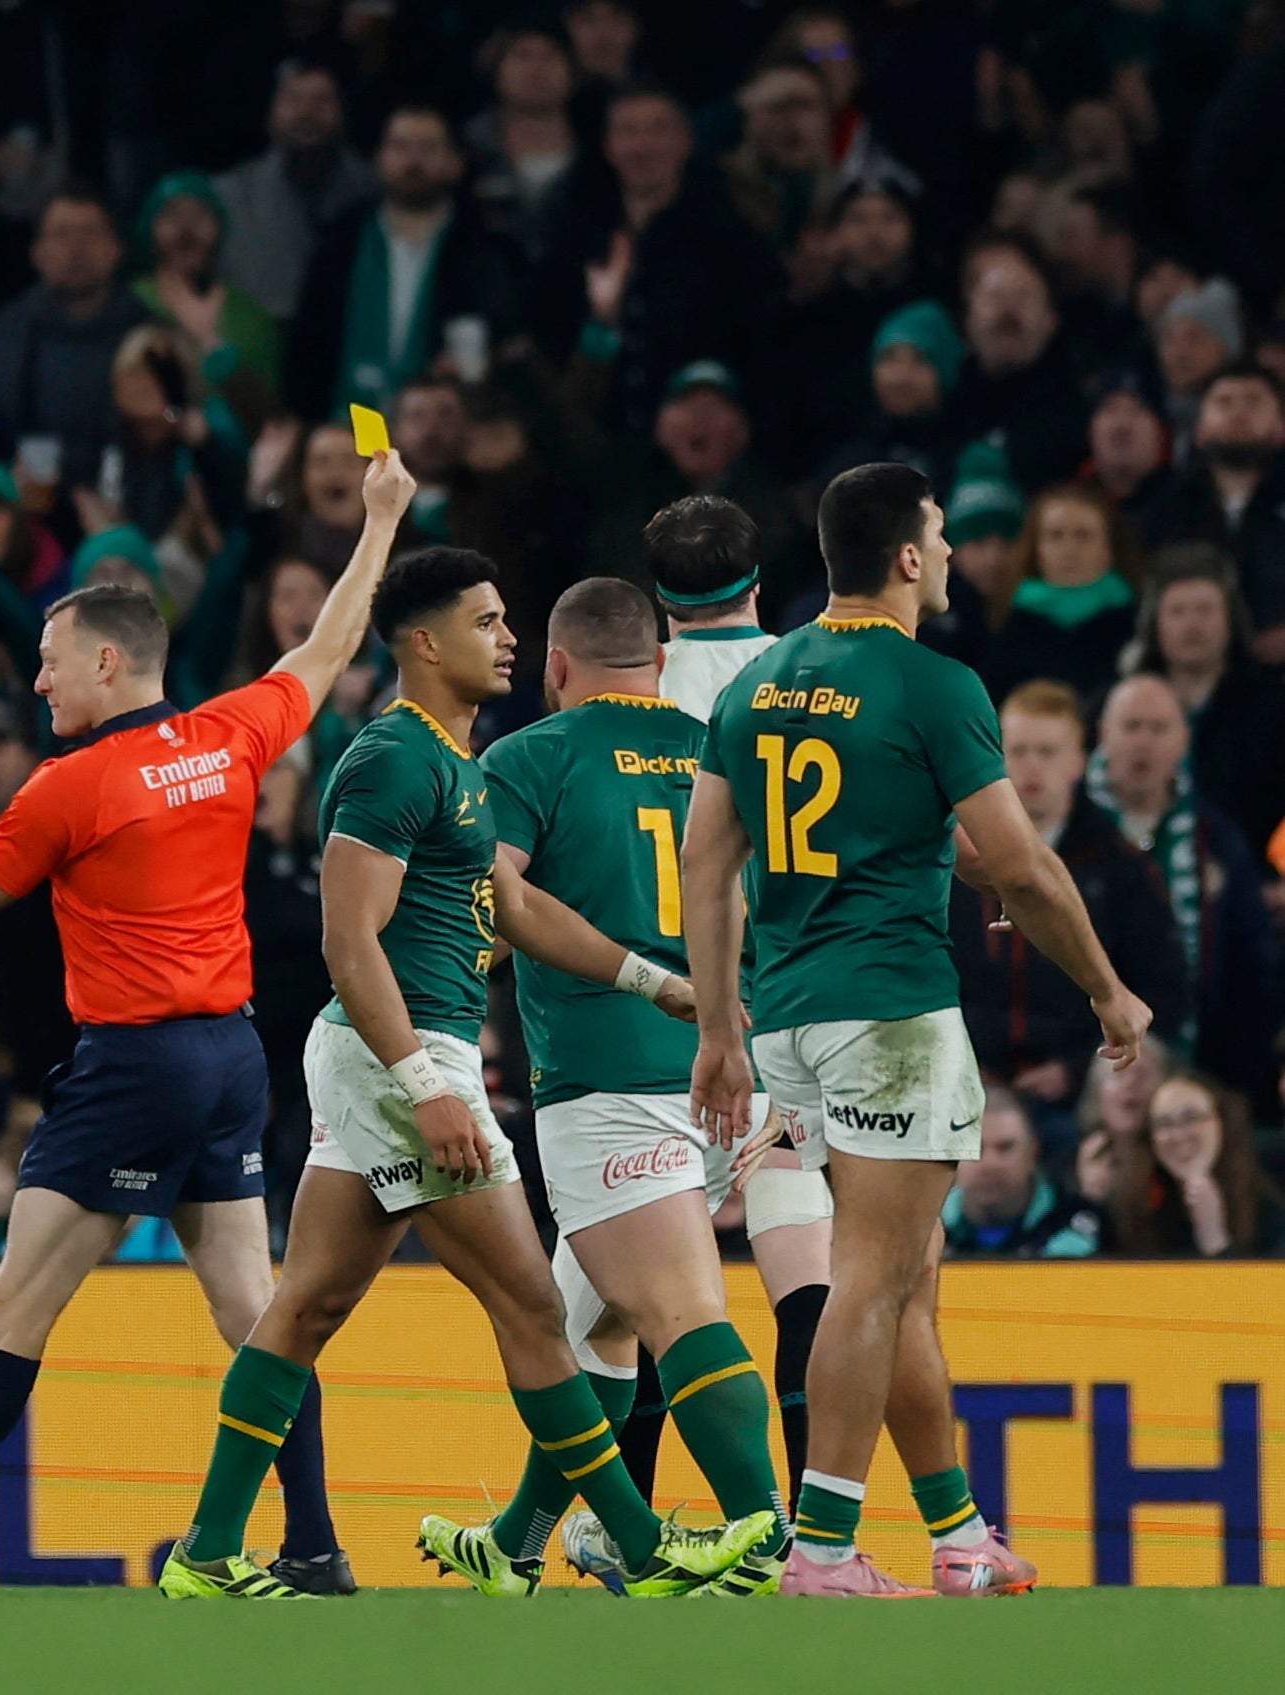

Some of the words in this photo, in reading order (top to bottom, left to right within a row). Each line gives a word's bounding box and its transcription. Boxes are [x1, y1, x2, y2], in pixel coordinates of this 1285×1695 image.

[138, 748, 231, 790] Emirates
[165, 784, 187, 809] FLY
[189, 773, 227, 802] BETTER
[755, 734, 842, 878] 12
[636, 806, 683, 937] 1
[365, 1157, 423, 1189] etway
[602, 1135, 690, 1190] Coca-Cola
